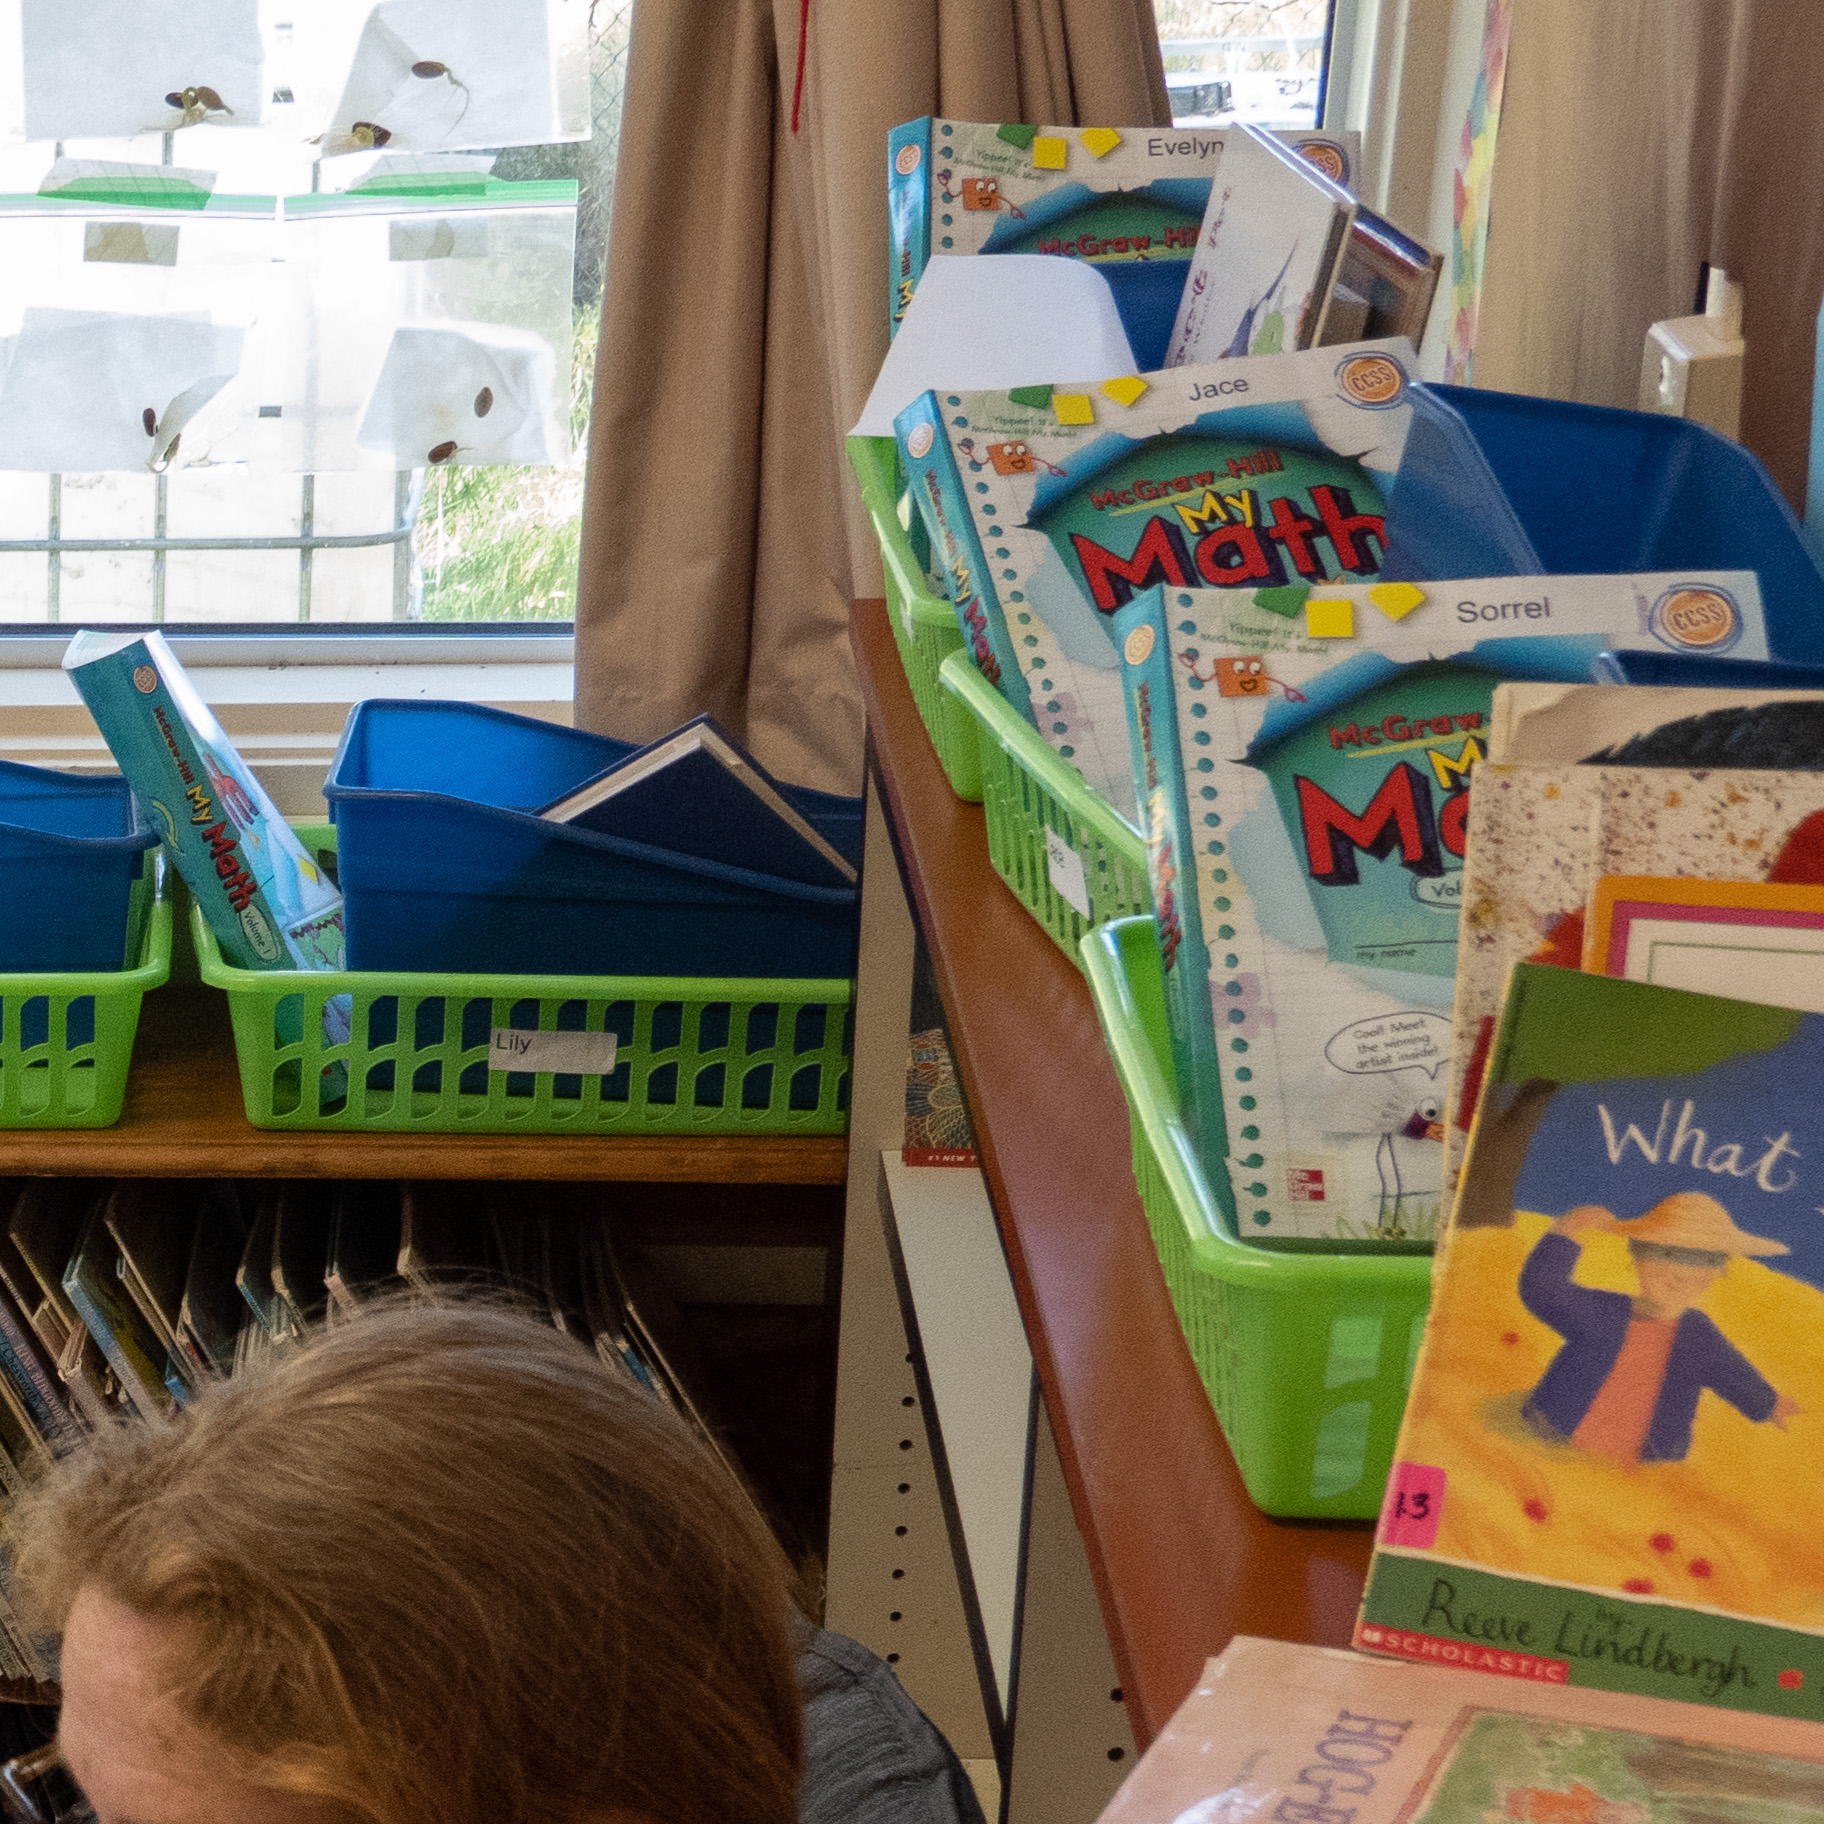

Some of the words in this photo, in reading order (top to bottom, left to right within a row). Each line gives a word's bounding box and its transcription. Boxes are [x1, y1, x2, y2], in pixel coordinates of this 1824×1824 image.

[1147, 138, 1225, 160] Evelyn
[1189, 377, 1250, 402] Jace
[1351, 365, 1393, 392] CCSS
[1090, 451, 1284, 511] McGraw-Hill
[1171, 489, 1256, 534] My
[1069, 484, 1390, 618] Math
[950, 556, 972, 605] My
[963, 597, 1002, 688] Math
[1456, 596, 1552, 624] Sorrel
[1670, 601, 1720, 632] CCSS
[153, 705, 195, 786] McGraw-Hill
[186, 783, 214, 825] My
[202, 821, 259, 913] Math
[1390, 1019, 1427, 1034] Meet
[494, 1032, 532, 1057] Lily
[1357, 1040, 1380, 1055] the
[1383, 1034, 1430, 1052] winning
[1355, 1054, 1393, 1070] artist
[1596, 1098, 1801, 1194] What
[1421, 1577, 1532, 1647] Reeve
[1553, 1611, 1759, 1701] Lindbergh
[1381, 1630, 1563, 1683] SCHOLASTIC
